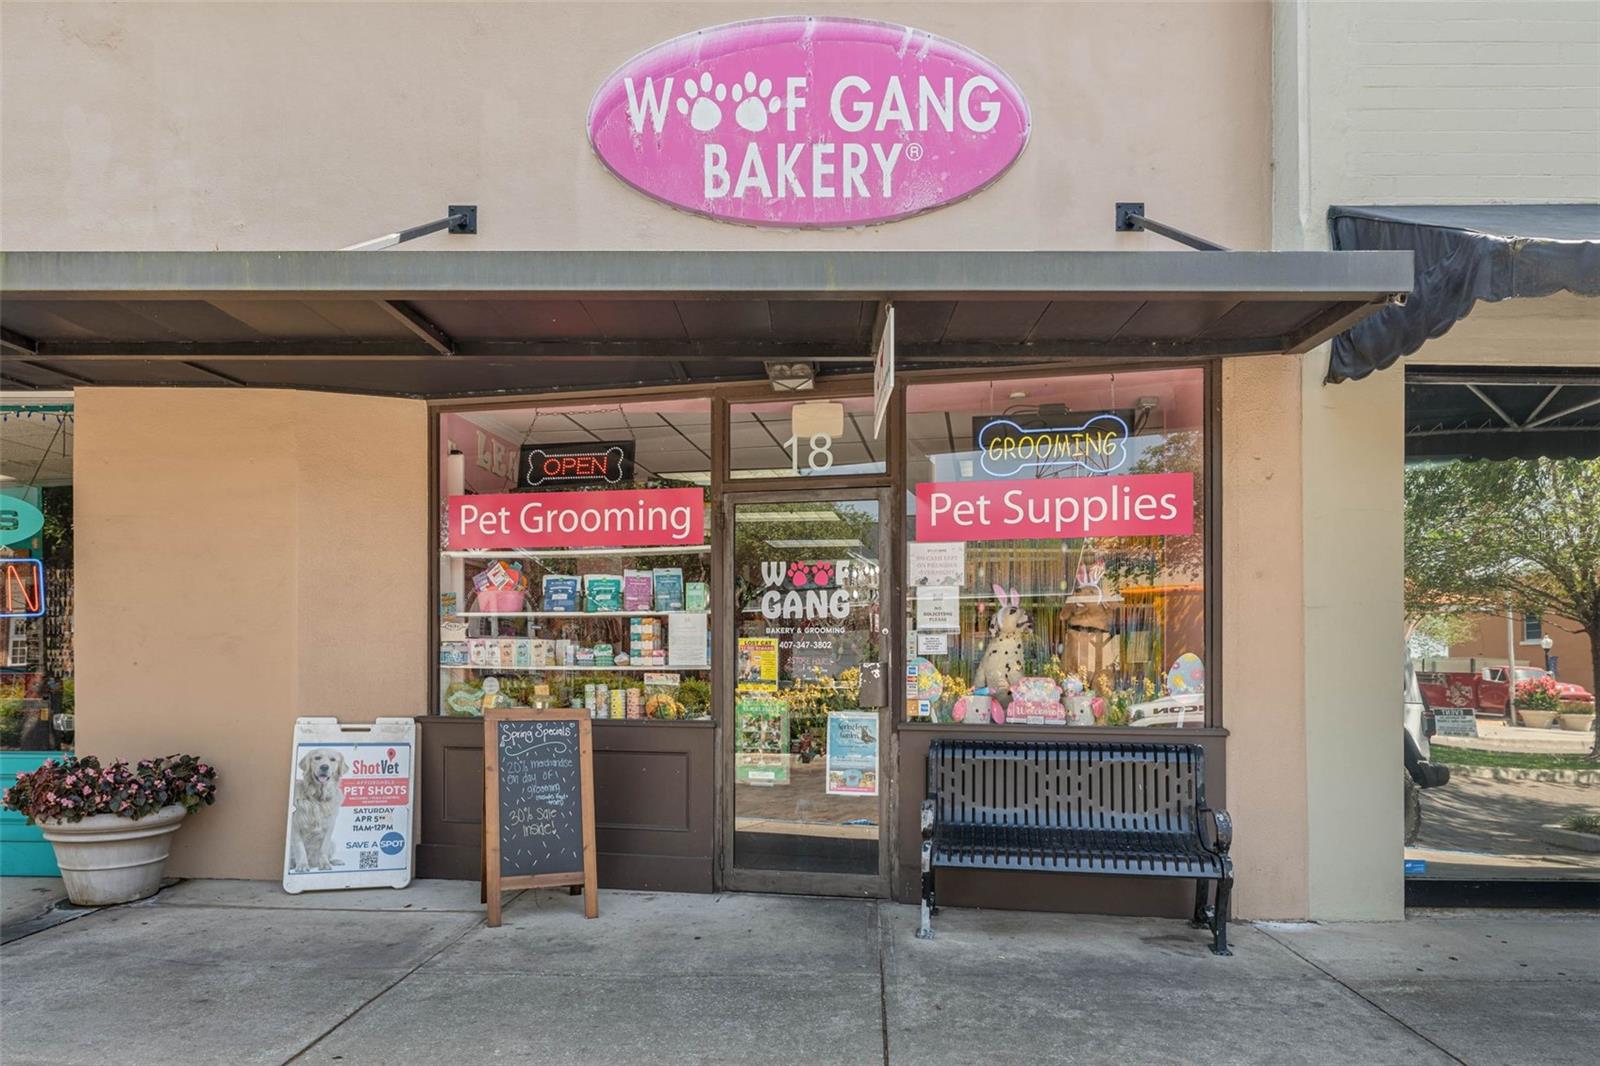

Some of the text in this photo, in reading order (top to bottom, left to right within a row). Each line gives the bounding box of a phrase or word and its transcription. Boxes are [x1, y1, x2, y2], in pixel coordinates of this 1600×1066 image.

[624, 72, 1001, 134] WF GANG
[783, 432, 834, 473] 18
[989, 431, 1117, 461] GROOMING
[543, 456, 608, 476] OPEN
[460, 500, 691, 540] Pet Grooming
[930, 485, 1178, 532] Pet Supplies
[761, 589, 850, 619] GANG
[779, 641, 832, 649] 407-347-3802
[501, 722, 571, 746] Spring Specials
[352, 760, 399, 774] ShotVet
[344, 785, 407, 796] PET SHOTS
[509, 807, 534, 826] 30%
[345, 841, 369, 849] SAVE
[380, 840, 404, 848] SPOT
